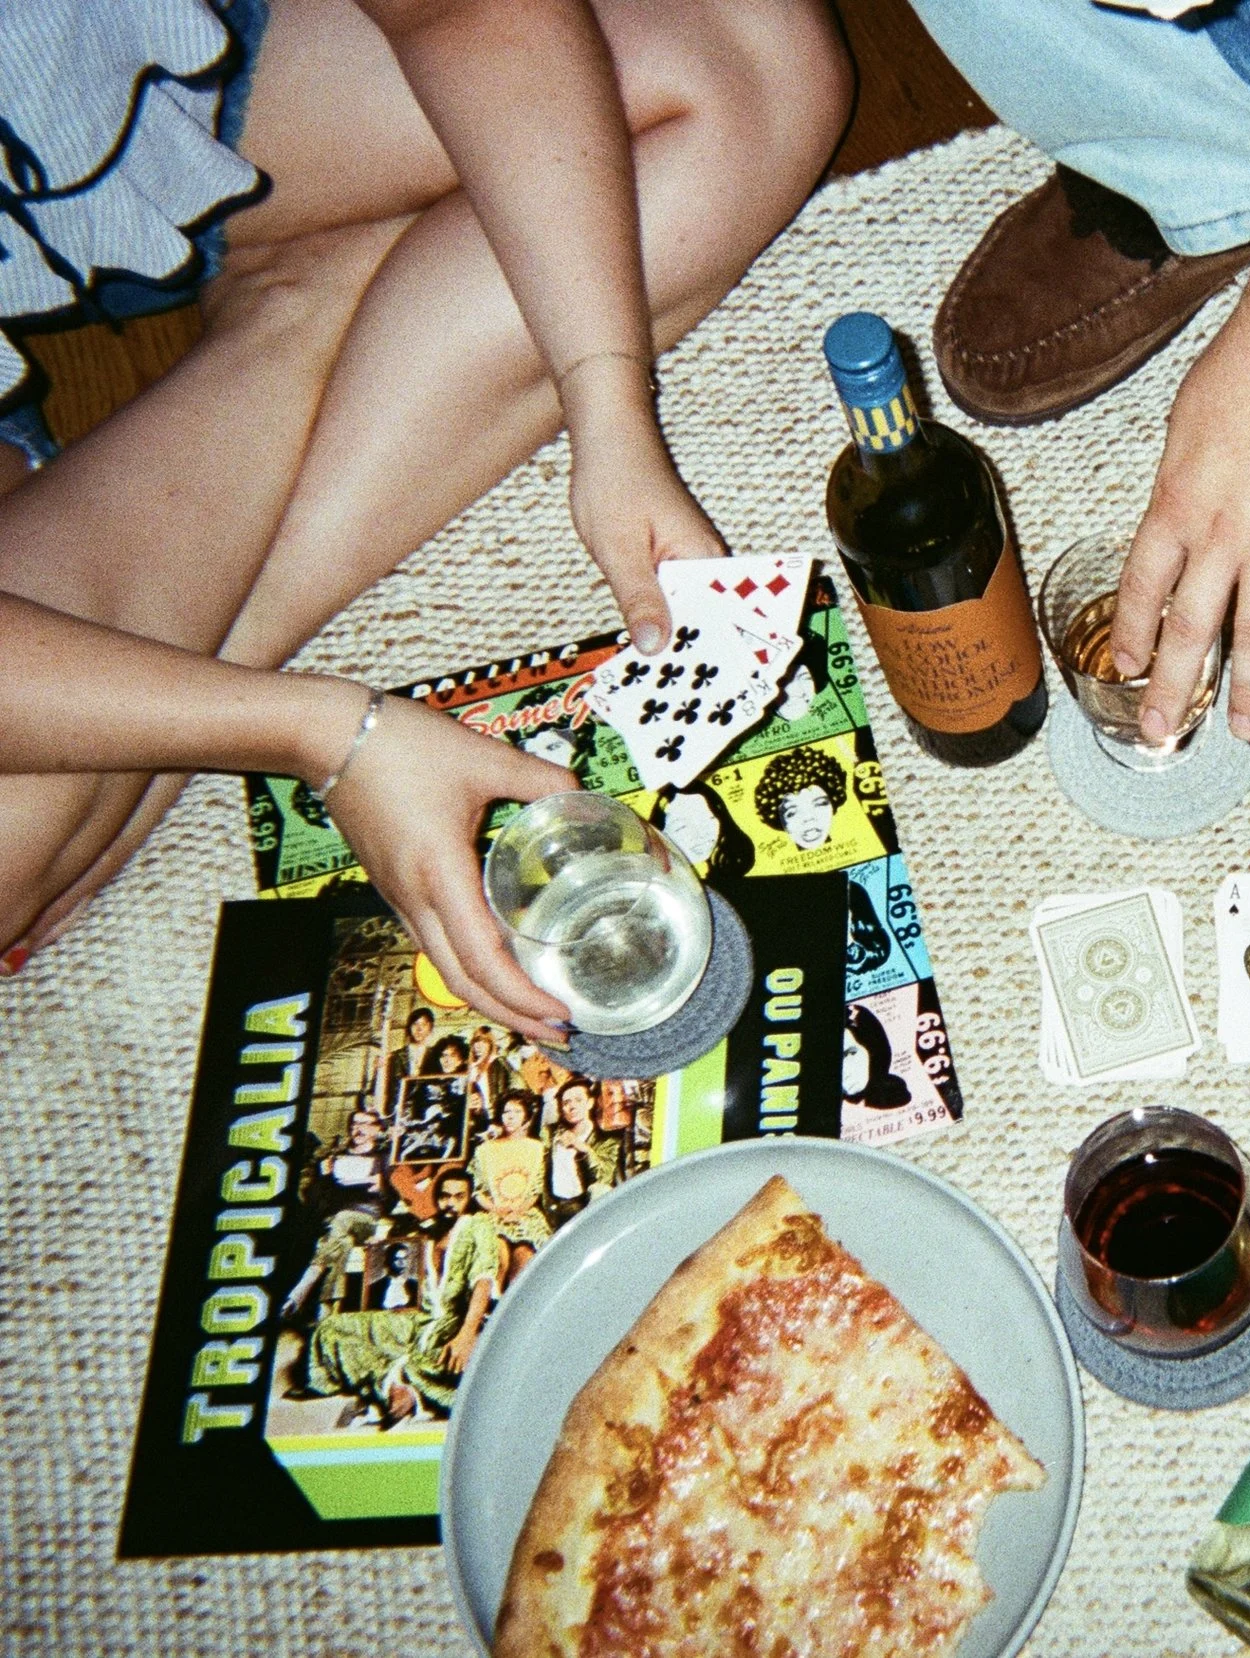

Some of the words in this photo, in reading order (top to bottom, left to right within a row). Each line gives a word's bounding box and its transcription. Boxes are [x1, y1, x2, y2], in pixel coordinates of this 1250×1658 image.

[458, 697, 560, 737] Some
[765, 967, 804, 1022] OU
[181, 992, 311, 1445] TROPICALIA
